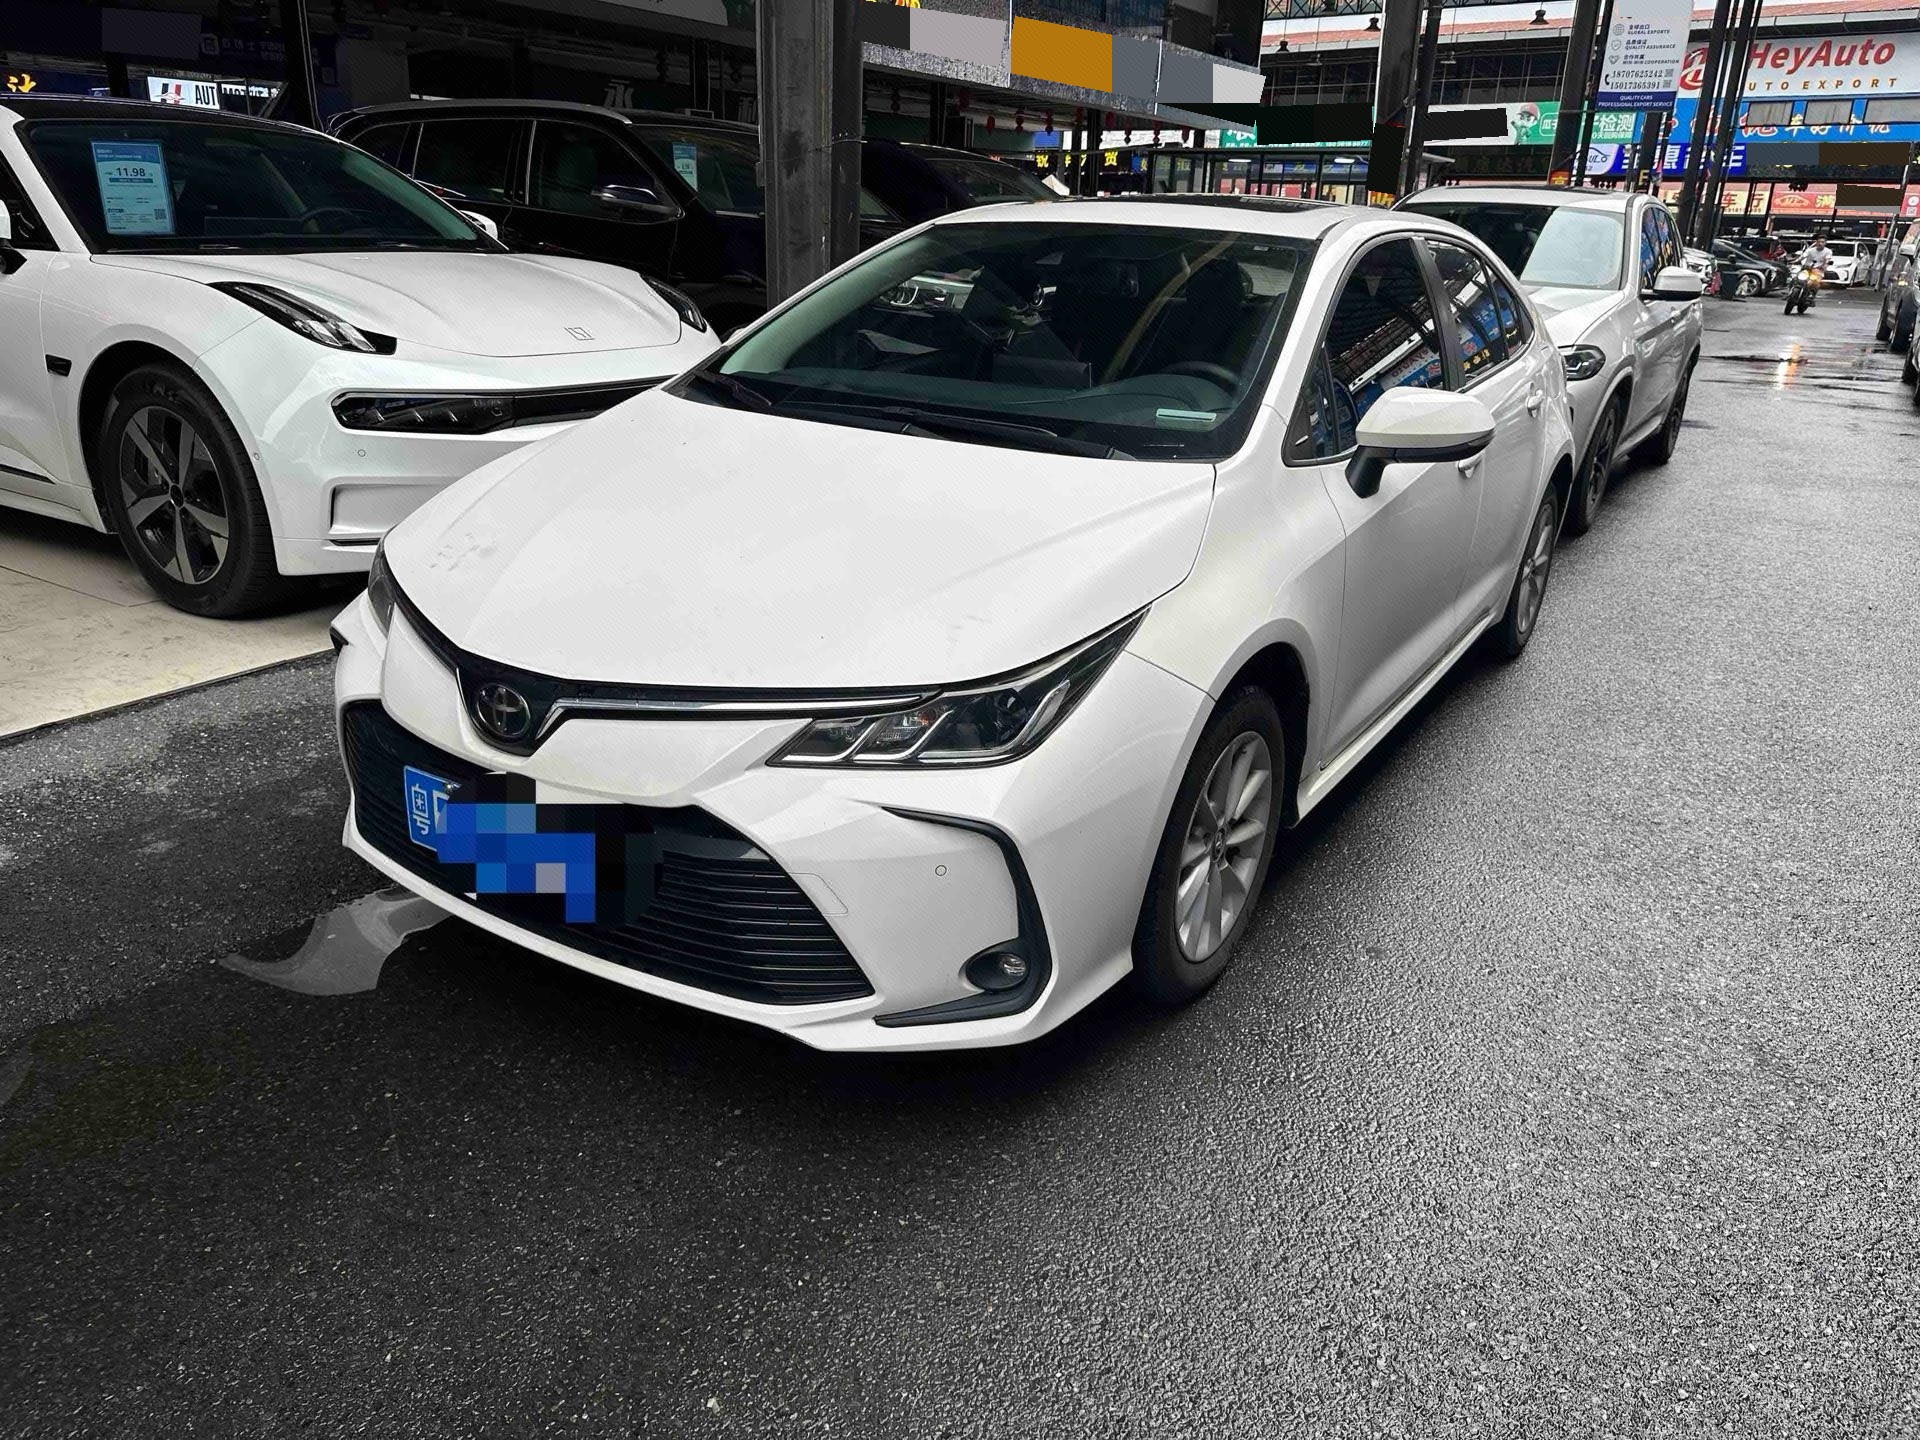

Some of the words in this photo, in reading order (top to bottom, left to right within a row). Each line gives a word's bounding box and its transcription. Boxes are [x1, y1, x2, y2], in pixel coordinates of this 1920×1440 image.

[1748, 38, 1896, 75] HeyAuto
[1612, 69, 1663, 79] 18707625242
[1610, 80, 1660, 90] 15017365391
[1749, 81, 1790, 91] UTO
[1802, 77, 1898, 90] EXPORT
[115, 167, 146, 177] 11.98
